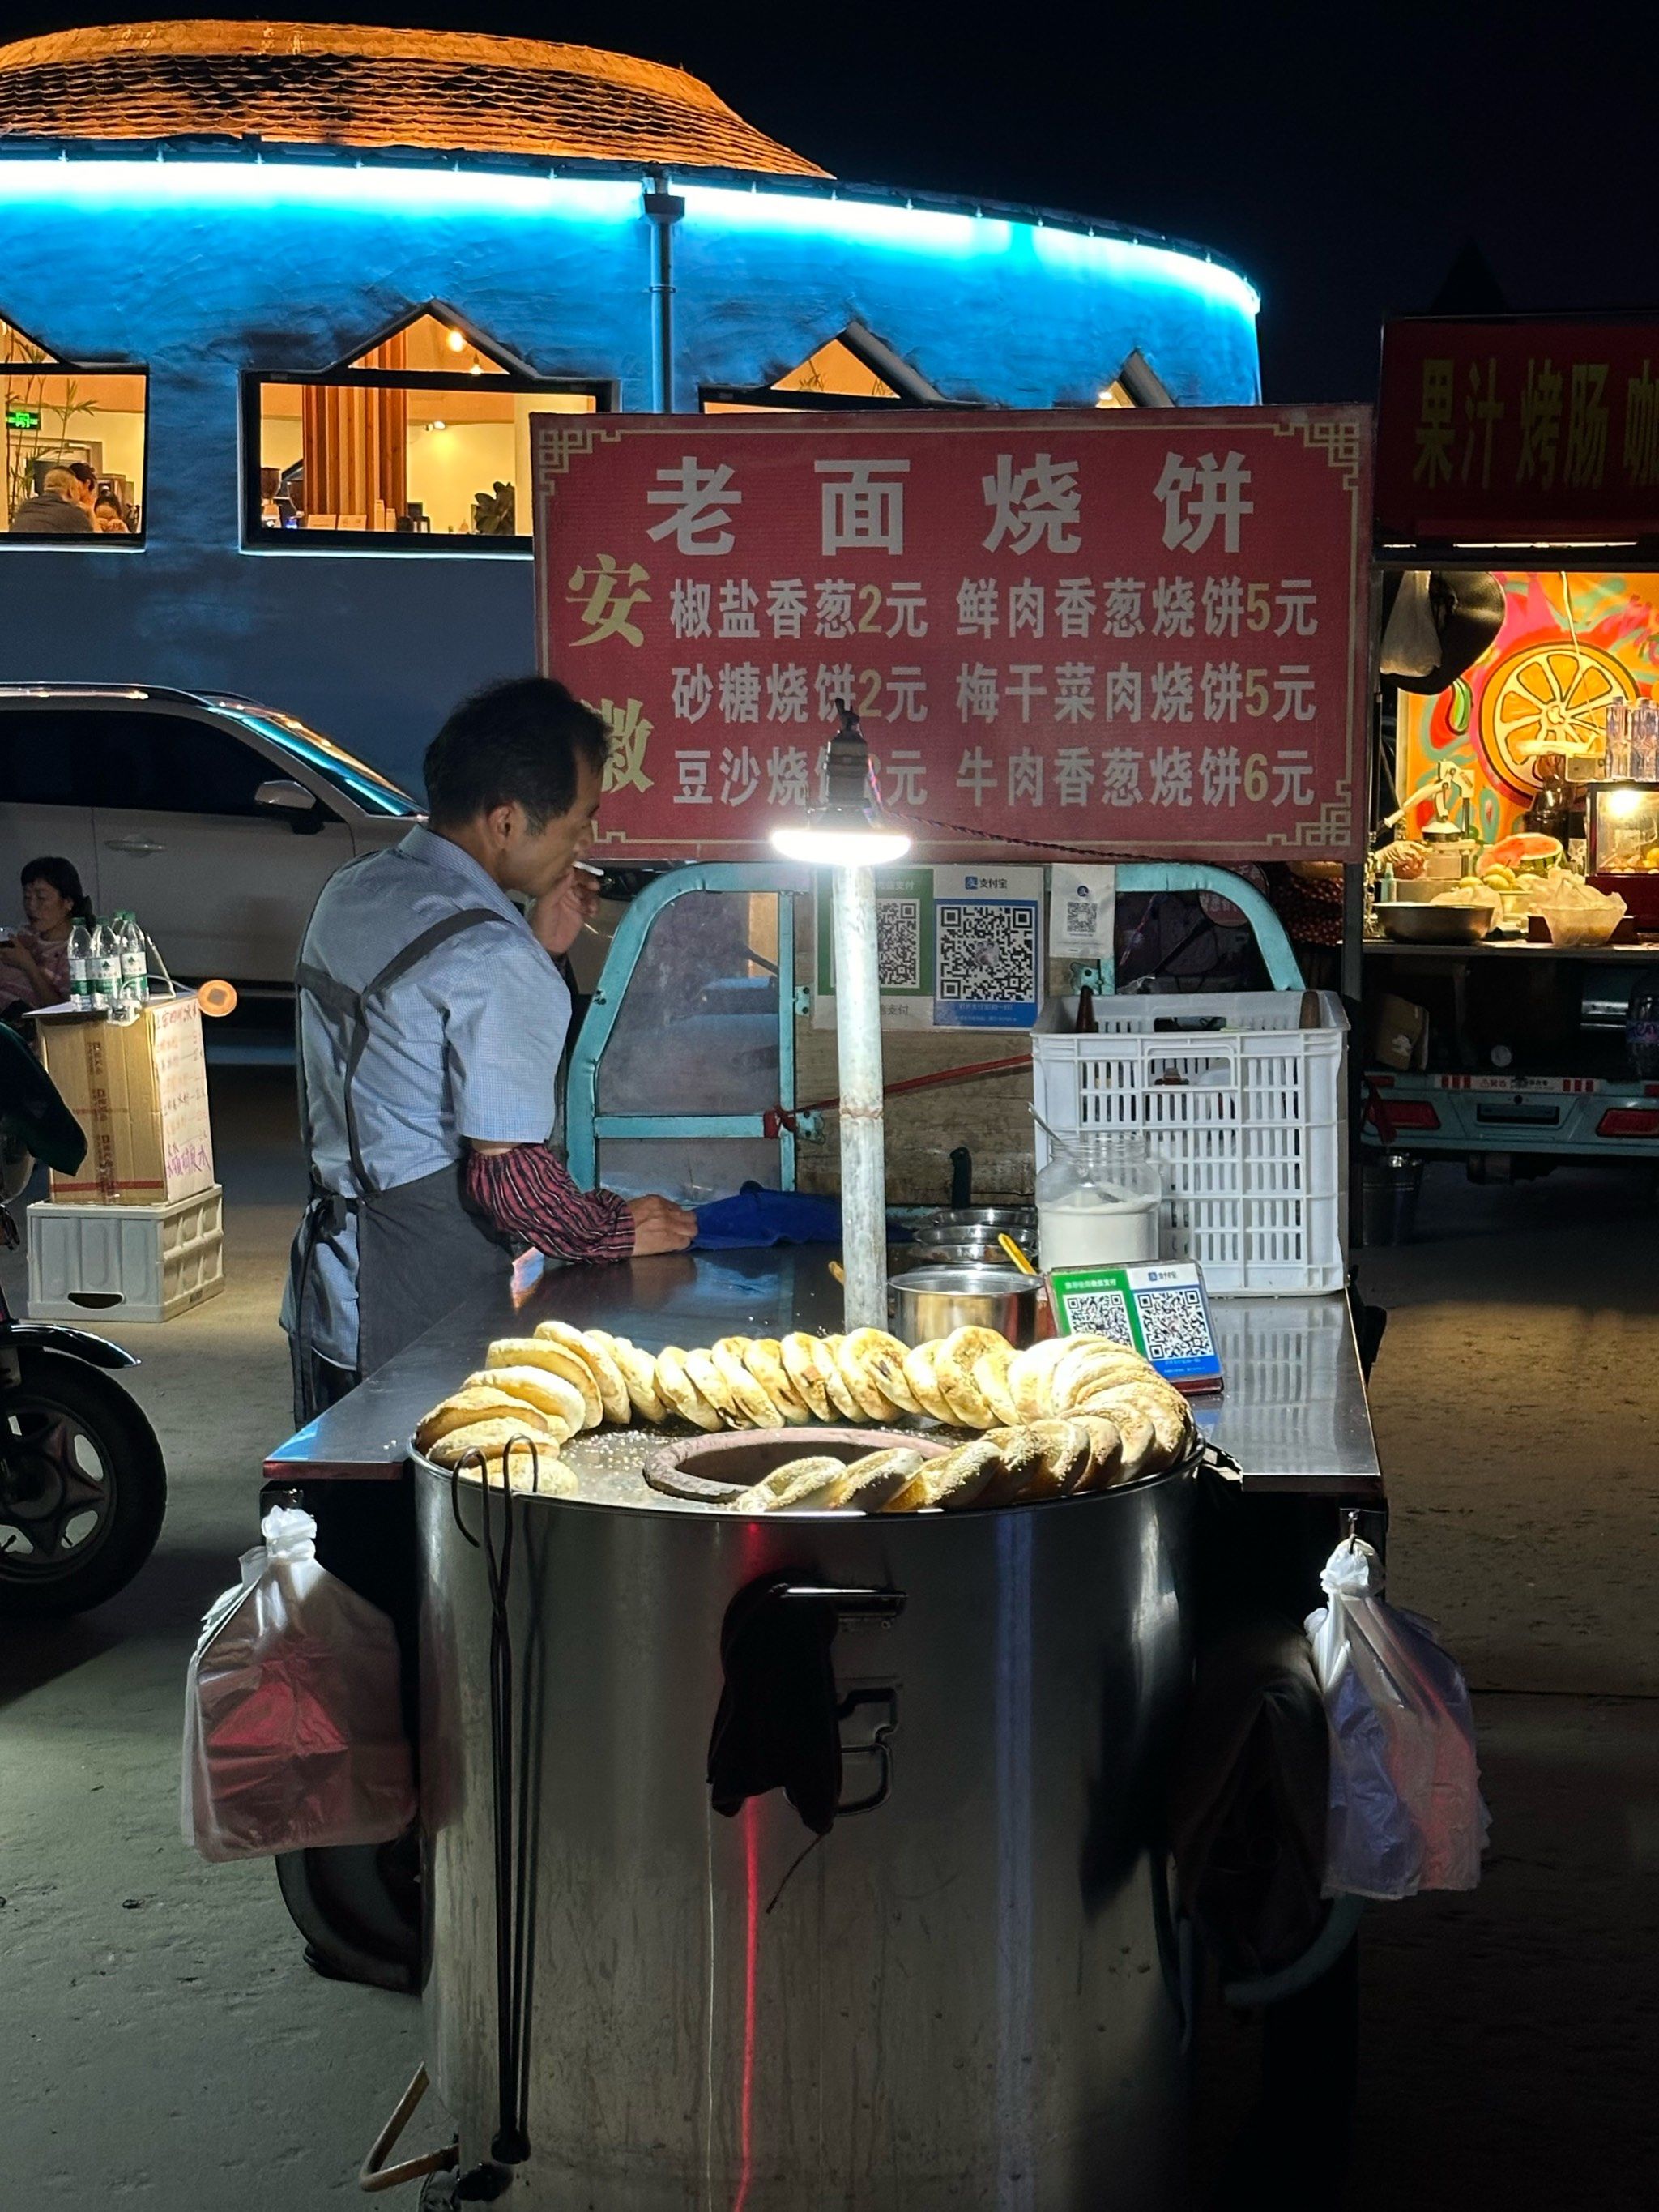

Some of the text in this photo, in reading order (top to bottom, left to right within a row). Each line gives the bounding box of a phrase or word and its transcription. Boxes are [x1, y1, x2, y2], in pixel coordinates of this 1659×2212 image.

[646, 450, 1254, 556] 老面烧饼
[669, 575, 1319, 640] 椒盐香葱2元 鲜肉香葱烧饼5元
[671, 660, 1317, 724] 砂糖烧饼2元 梅干菜肉烧饼5元
[672, 745, 1316, 808] 豆沙烧元 牛肉香葱烧饼6元
[979, 878, 1008, 890] 支付宝
